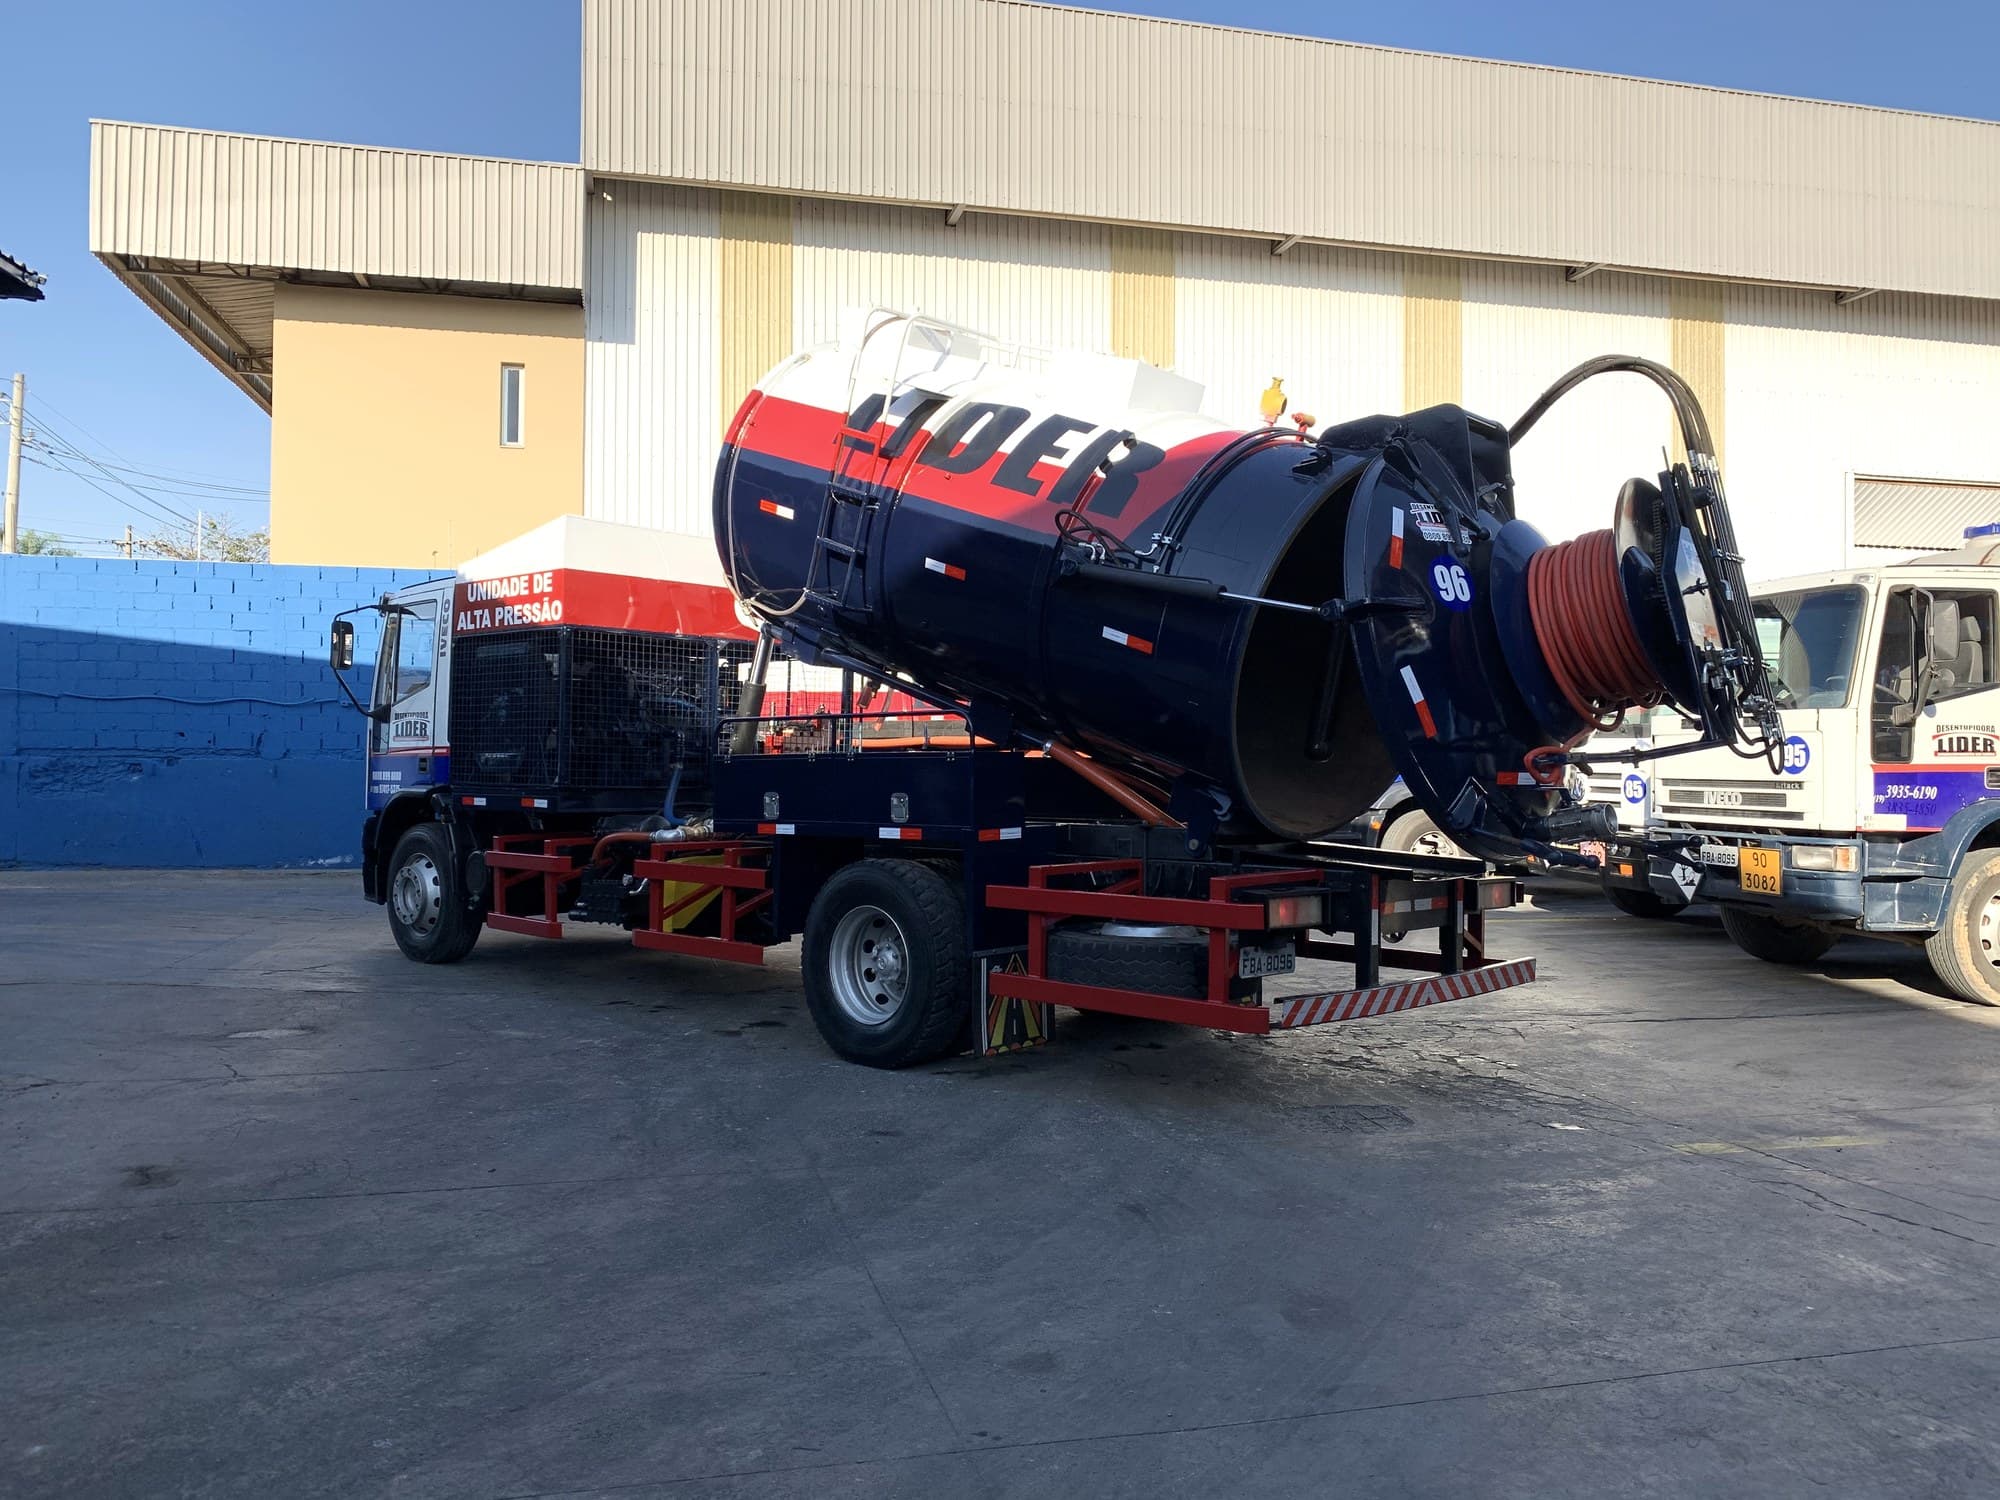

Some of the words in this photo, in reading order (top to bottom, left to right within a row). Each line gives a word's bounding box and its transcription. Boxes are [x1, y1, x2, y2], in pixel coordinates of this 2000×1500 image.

[467, 575, 529, 602] UNIDADE
[533, 572, 553, 594] DE
[1434, 564, 1471, 602] 96
[456, 608, 492, 631] ALTA
[495, 597, 563, 627] PRESSÃO
[439, 598, 451, 658] IVECO
[395, 720, 428, 737] LIDER
[1936, 724, 1996, 734] DESENTUPIDORA
[1937, 736, 1996, 753] LIDER
[1783, 743, 1806, 768] 95
[1625, 779, 1644, 799] 85
[1703, 790, 1743, 806] IVECO
[1885, 784, 1938, 800] 3935-6190
[1752, 851, 1768, 868] 90
[1745, 873, 1776, 892] 3082
